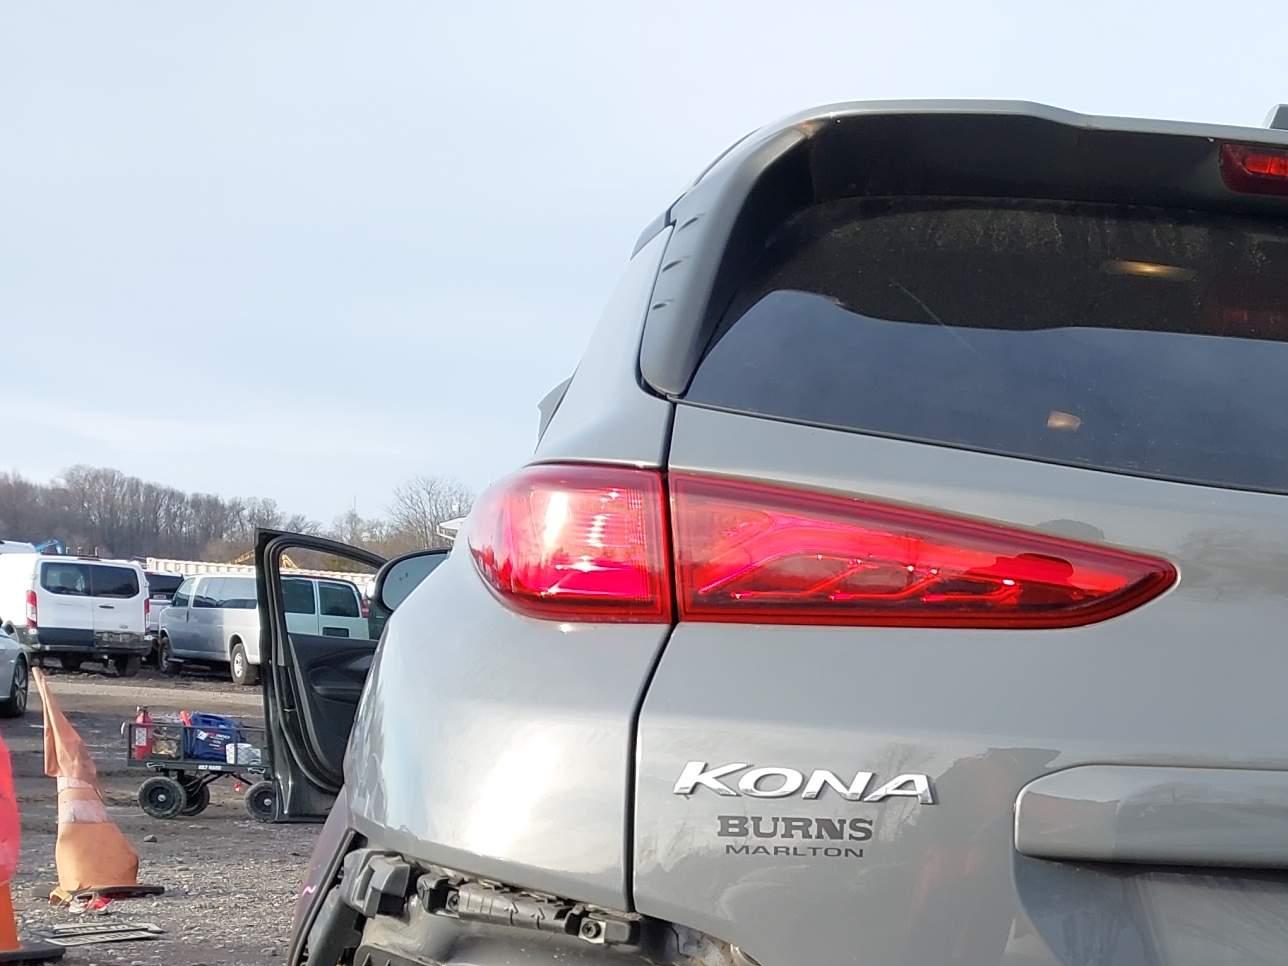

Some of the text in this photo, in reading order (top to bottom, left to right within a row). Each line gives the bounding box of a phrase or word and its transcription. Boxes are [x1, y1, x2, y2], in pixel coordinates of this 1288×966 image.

[673, 761, 933, 804] KONA
[716, 815, 873, 841] BURNS
[725, 844, 864, 858] MARLTON
